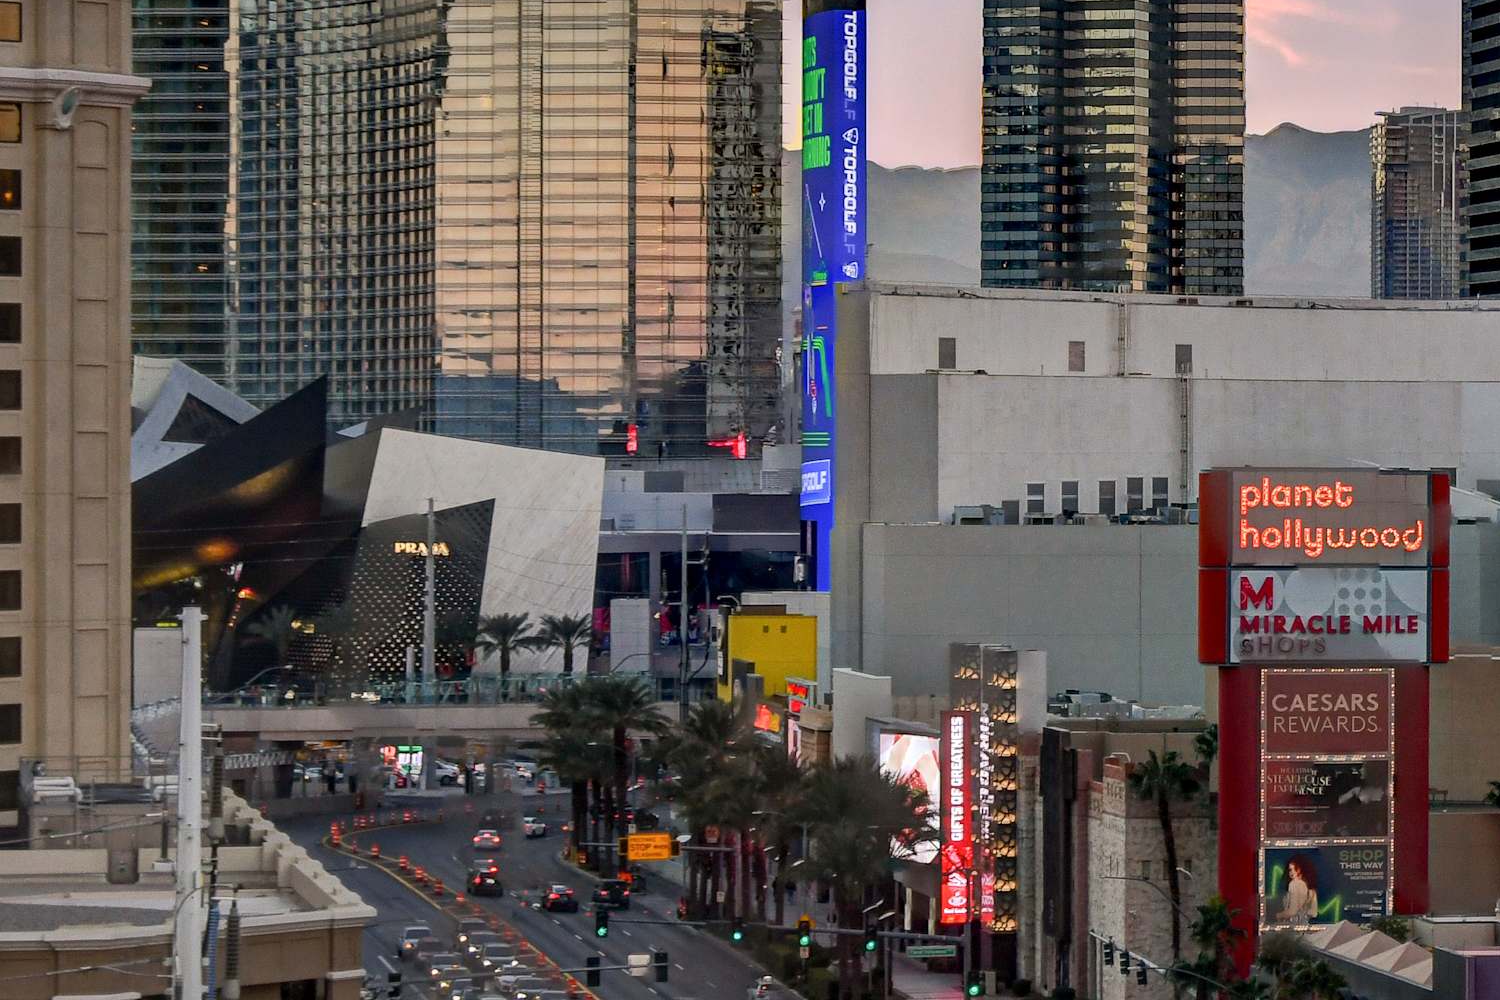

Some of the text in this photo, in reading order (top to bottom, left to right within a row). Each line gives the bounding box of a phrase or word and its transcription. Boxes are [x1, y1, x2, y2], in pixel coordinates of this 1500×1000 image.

[842, 12, 858, 101] TOPGOLF
[842, 145, 858, 235] TOPGOLF
[1239, 475, 1354, 516] planet
[1239, 518, 1425, 559] hollywood
[1239, 615, 1419, 634] MIRACLE MILE
[1239, 636, 1327, 655] SHOPS
[1271, 693, 1379, 712] CAESARS
[1273, 715, 1378, 733] REWARDS
[951, 716, 964, 841] GIFTS OF GREATNESS
[1340, 849, 1384, 861] SHOP
[1362, 862, 1384, 870] WAY
